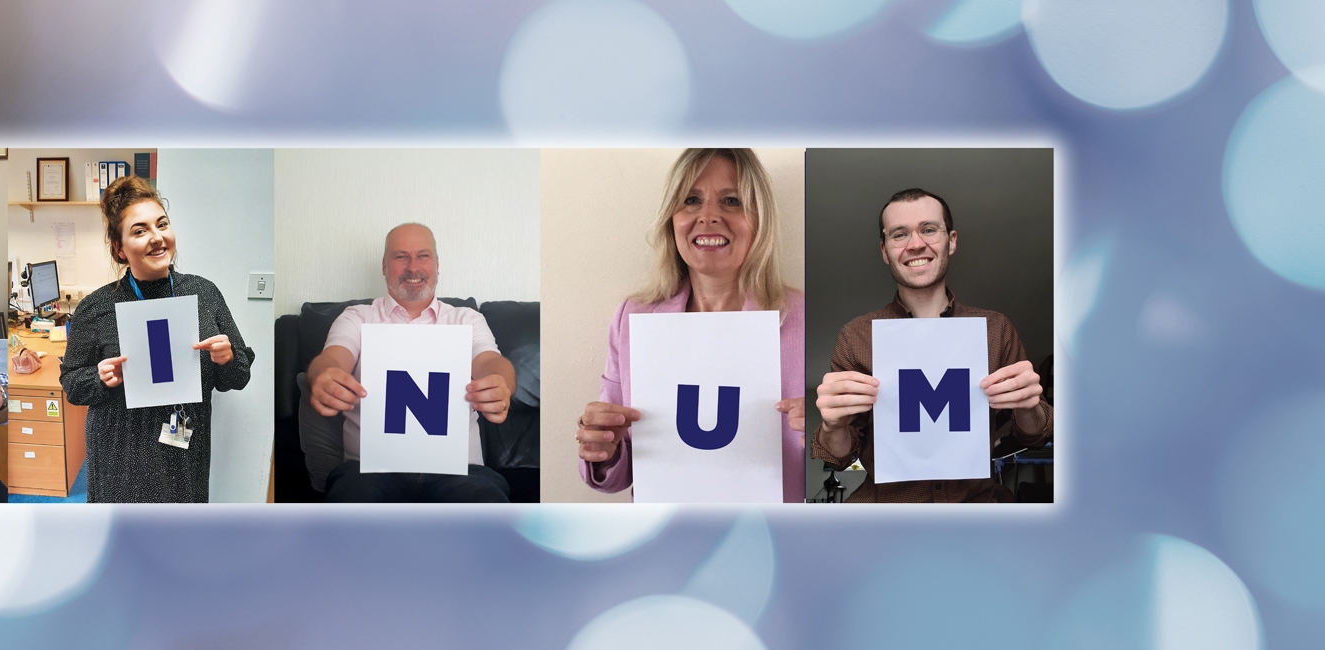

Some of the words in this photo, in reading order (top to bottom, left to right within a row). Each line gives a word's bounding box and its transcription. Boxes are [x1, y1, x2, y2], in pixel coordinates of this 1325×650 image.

[147, 319, 174, 383] I
[384, 370, 450, 436] N
[676, 384, 740, 450] U
[899, 368, 971, 433] M
